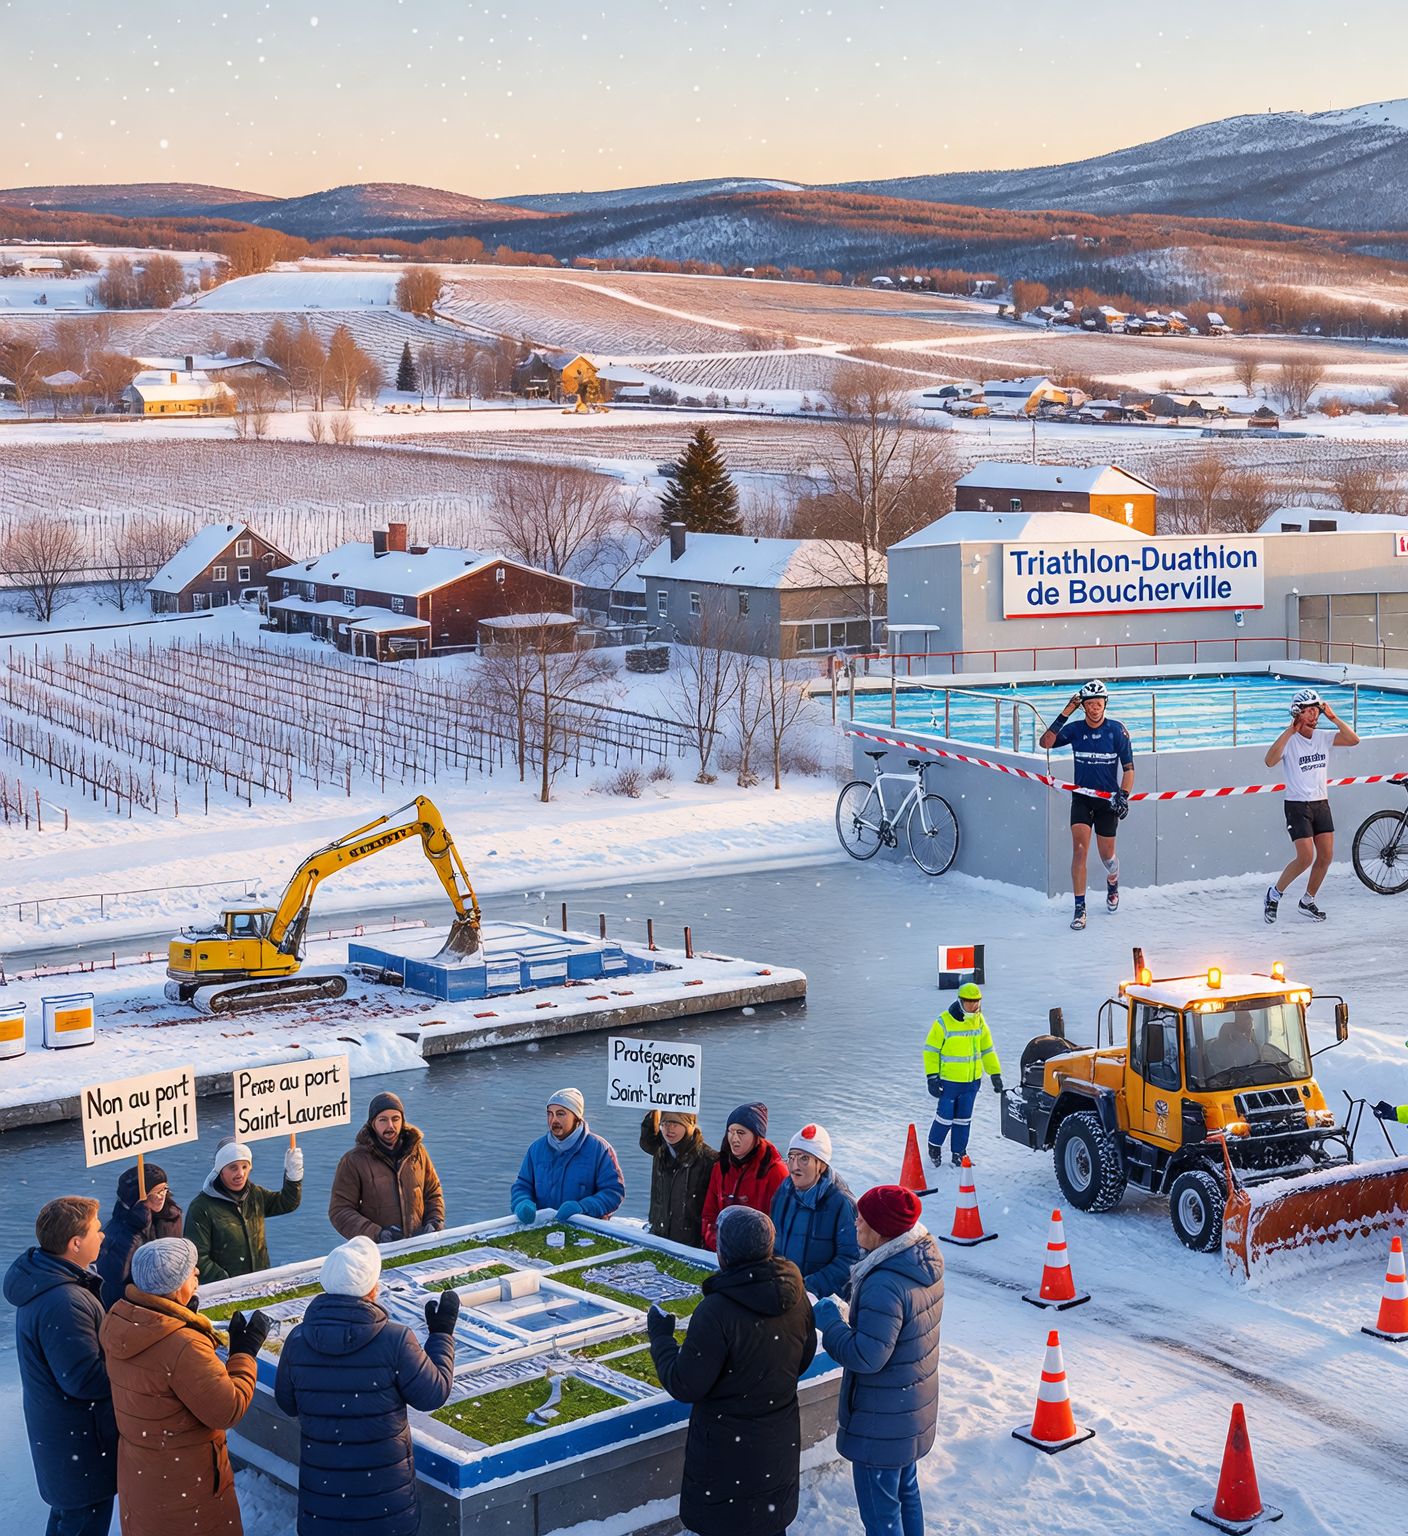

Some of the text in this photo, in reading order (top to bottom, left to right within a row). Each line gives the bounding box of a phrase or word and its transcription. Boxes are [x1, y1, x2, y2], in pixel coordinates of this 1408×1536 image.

[1026, 575, 1232, 606] de Boucherville
[88, 1074, 190, 1119] Non au port
[279, 1076, 299, 1091] au
[304, 1064, 341, 1097] port
[610, 1078, 697, 1107] Saint-Laurent
[238, 1092, 349, 1134] Saint-Laurent
